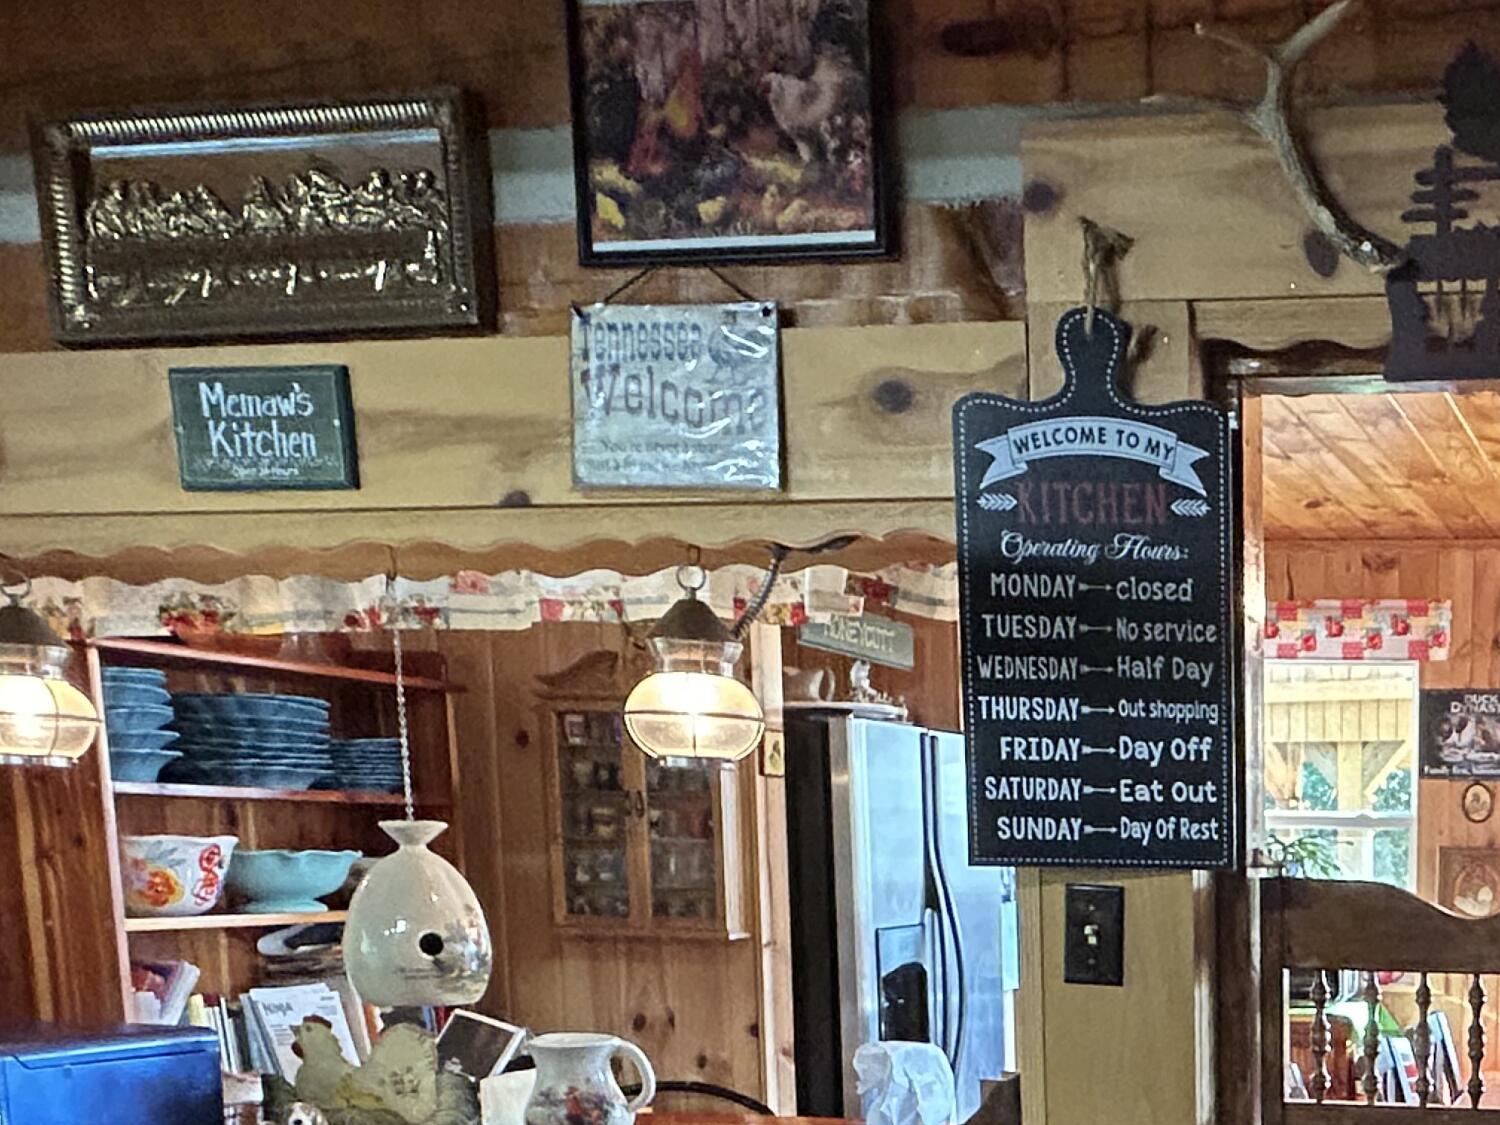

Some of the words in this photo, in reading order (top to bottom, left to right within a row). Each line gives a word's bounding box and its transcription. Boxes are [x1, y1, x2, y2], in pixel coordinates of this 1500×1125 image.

[199, 382, 315, 418] Memaw's
[580, 363, 768, 436] Welcome
[208, 419, 317, 458] Kitchen
[1013, 427, 1107, 454] WELCOME
[1116, 429, 1140, 448] TO
[1144, 437, 1174, 461] MY
[1016, 481, 1167, 525] KITCHEN
[1000, 530, 1101, 565] Operating
[990, 573, 1077, 598] MONDAY
[1116, 577, 1194, 602] closed
[982, 614, 1078, 639] TUESDAY
[1116, 617, 1138, 642] No
[1143, 619, 1218, 643] service
[976, 655, 1079, 681] WEDNESDAY
[1117, 656, 1166, 680] Half
[1172, 657, 1214, 687] Day
[978, 696, 1080, 722] THURSDAY
[1118, 699, 1146, 718] Out
[1149, 701, 1219, 724] shopping
[1464, 694, 1498, 703] DUCK
[1000, 736, 1081, 761] FRIDAY
[1118, 736, 1164, 767] Day
[1171, 737, 1213, 761] Off
[985, 776, 1082, 801] SATURDAY
[1119, 779, 1164, 802] Eat
[1171, 781, 1217, 803] Out
[997, 816, 1082, 840] SUNDAY
[1120, 816, 1151, 845] Day
[1156, 816, 1176, 840] Of
[1180, 817, 1219, 840] Rest
